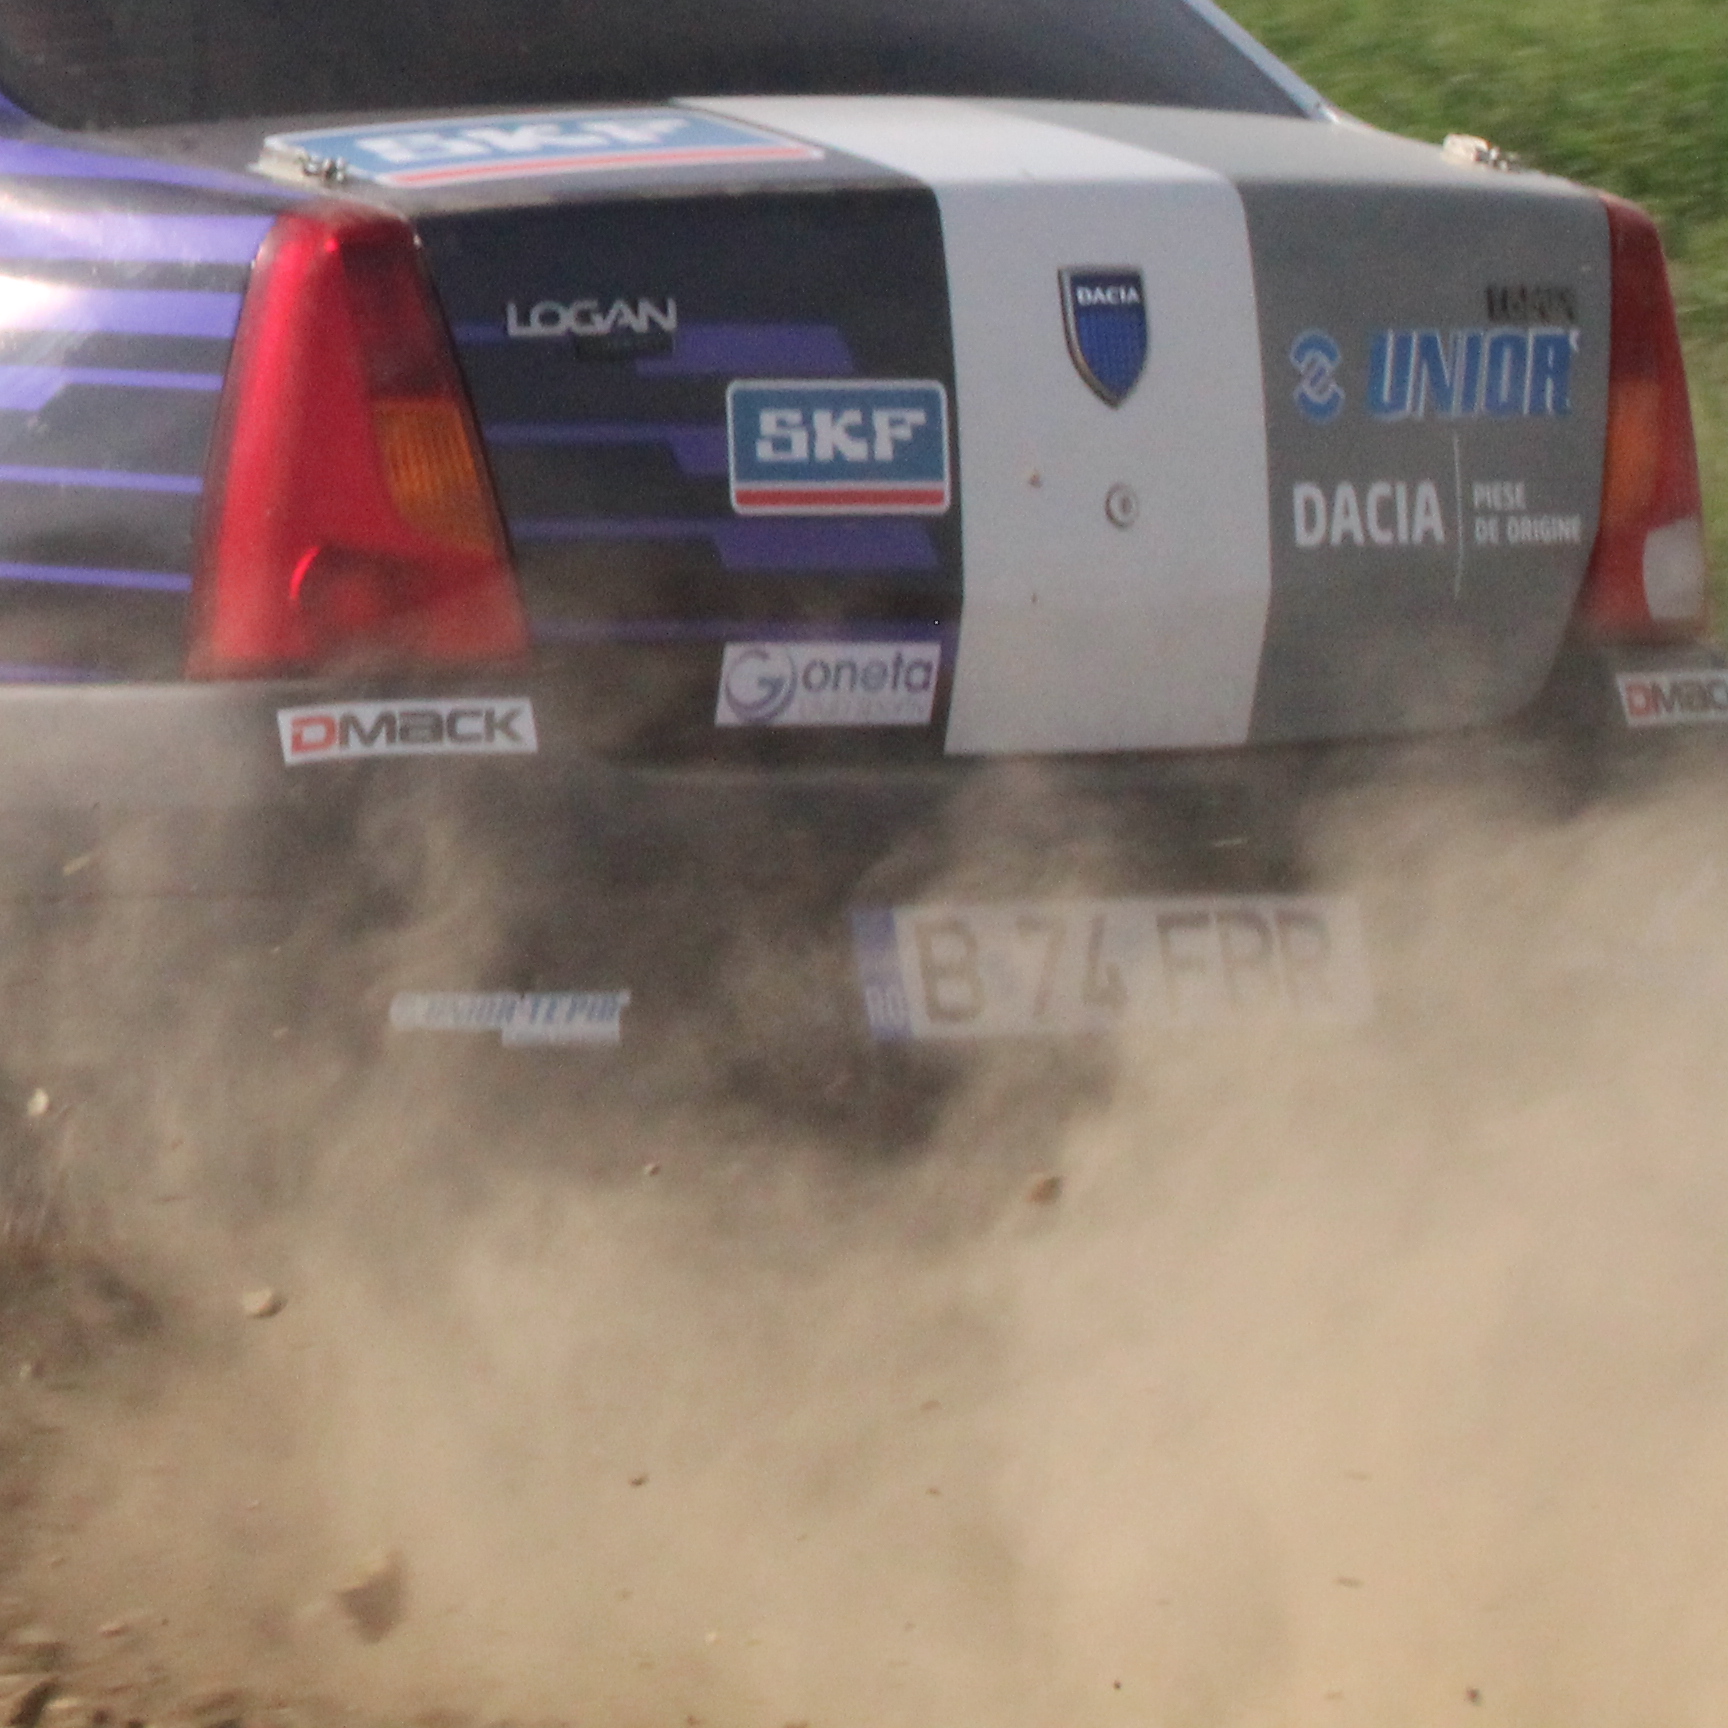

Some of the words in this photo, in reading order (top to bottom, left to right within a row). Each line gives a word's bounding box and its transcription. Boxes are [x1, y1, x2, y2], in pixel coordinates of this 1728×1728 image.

[506, 298, 678, 338] LOGAN
[1076, 285, 1142, 306] DACIA
[1366, 326, 1572, 423] UNIOR
[754, 407, 928, 463] SKF
[1292, 480, 1444, 549] DACIA
